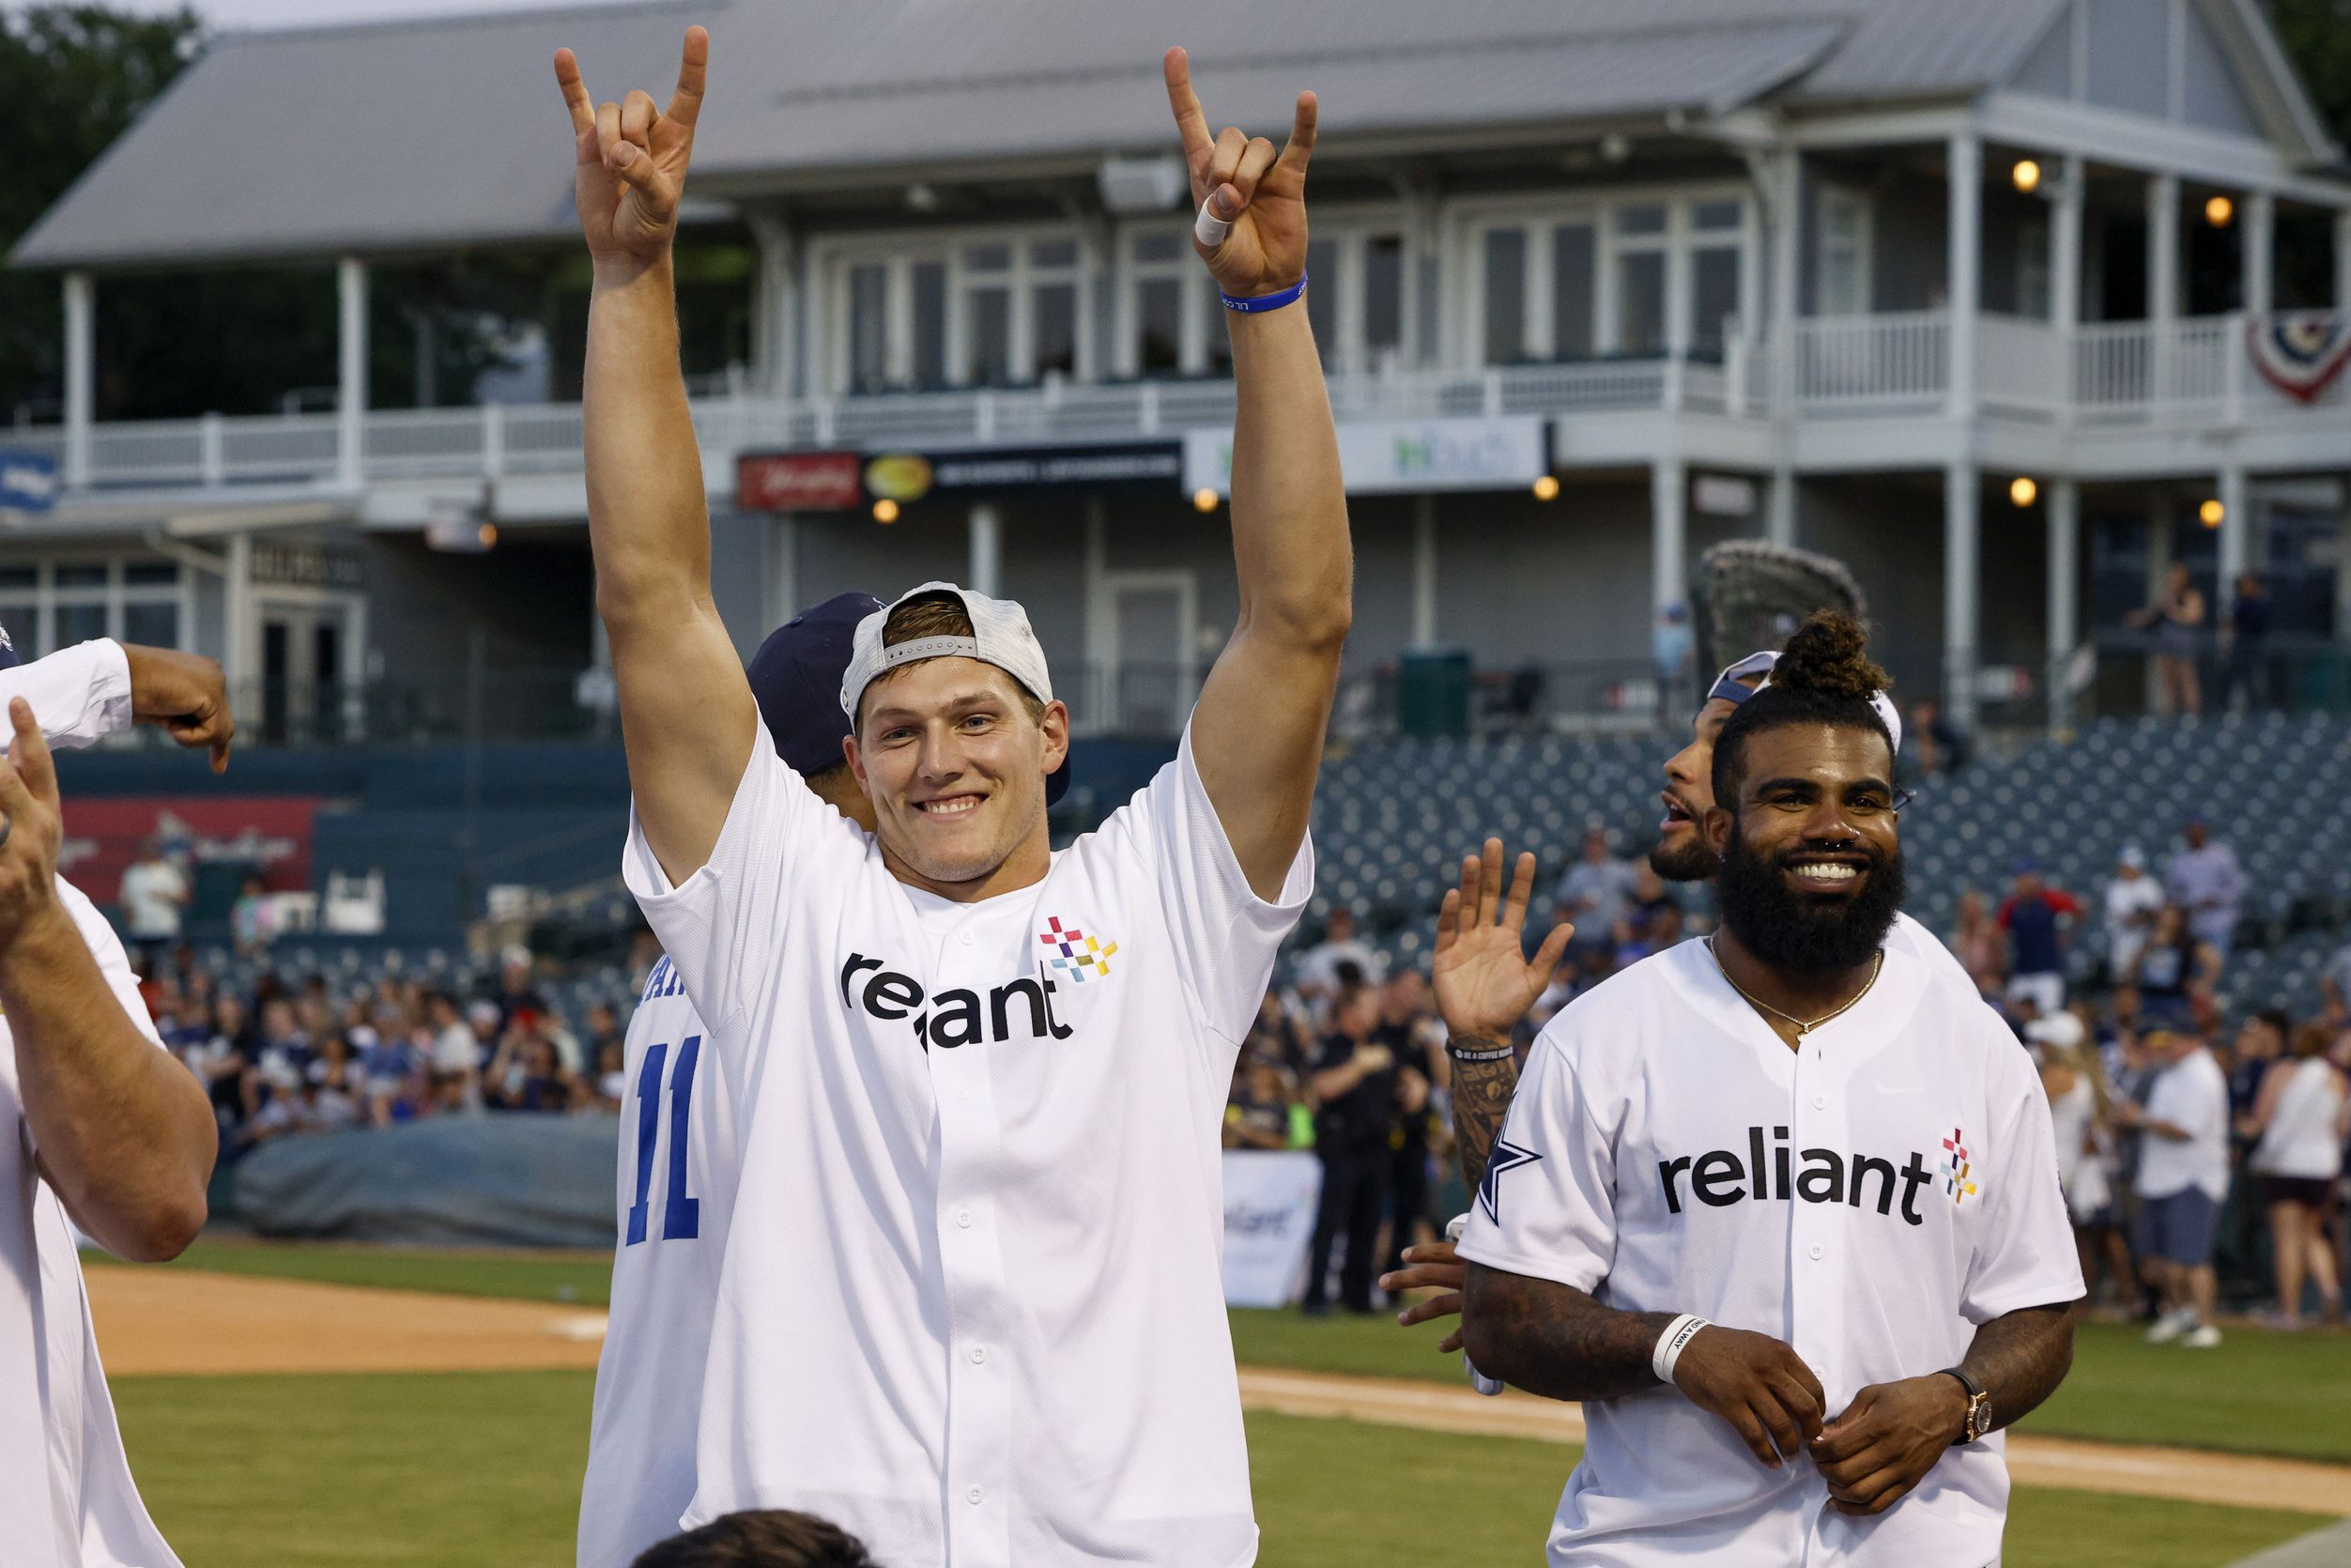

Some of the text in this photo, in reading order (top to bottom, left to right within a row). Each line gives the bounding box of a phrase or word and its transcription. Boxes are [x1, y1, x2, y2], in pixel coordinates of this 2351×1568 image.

[626, 1036, 701, 1247] 11
[1659, 1126, 1932, 1226] reliant
[1674, 1333, 1689, 1349] WAY
[1693, 1319, 1706, 1328] FIND
